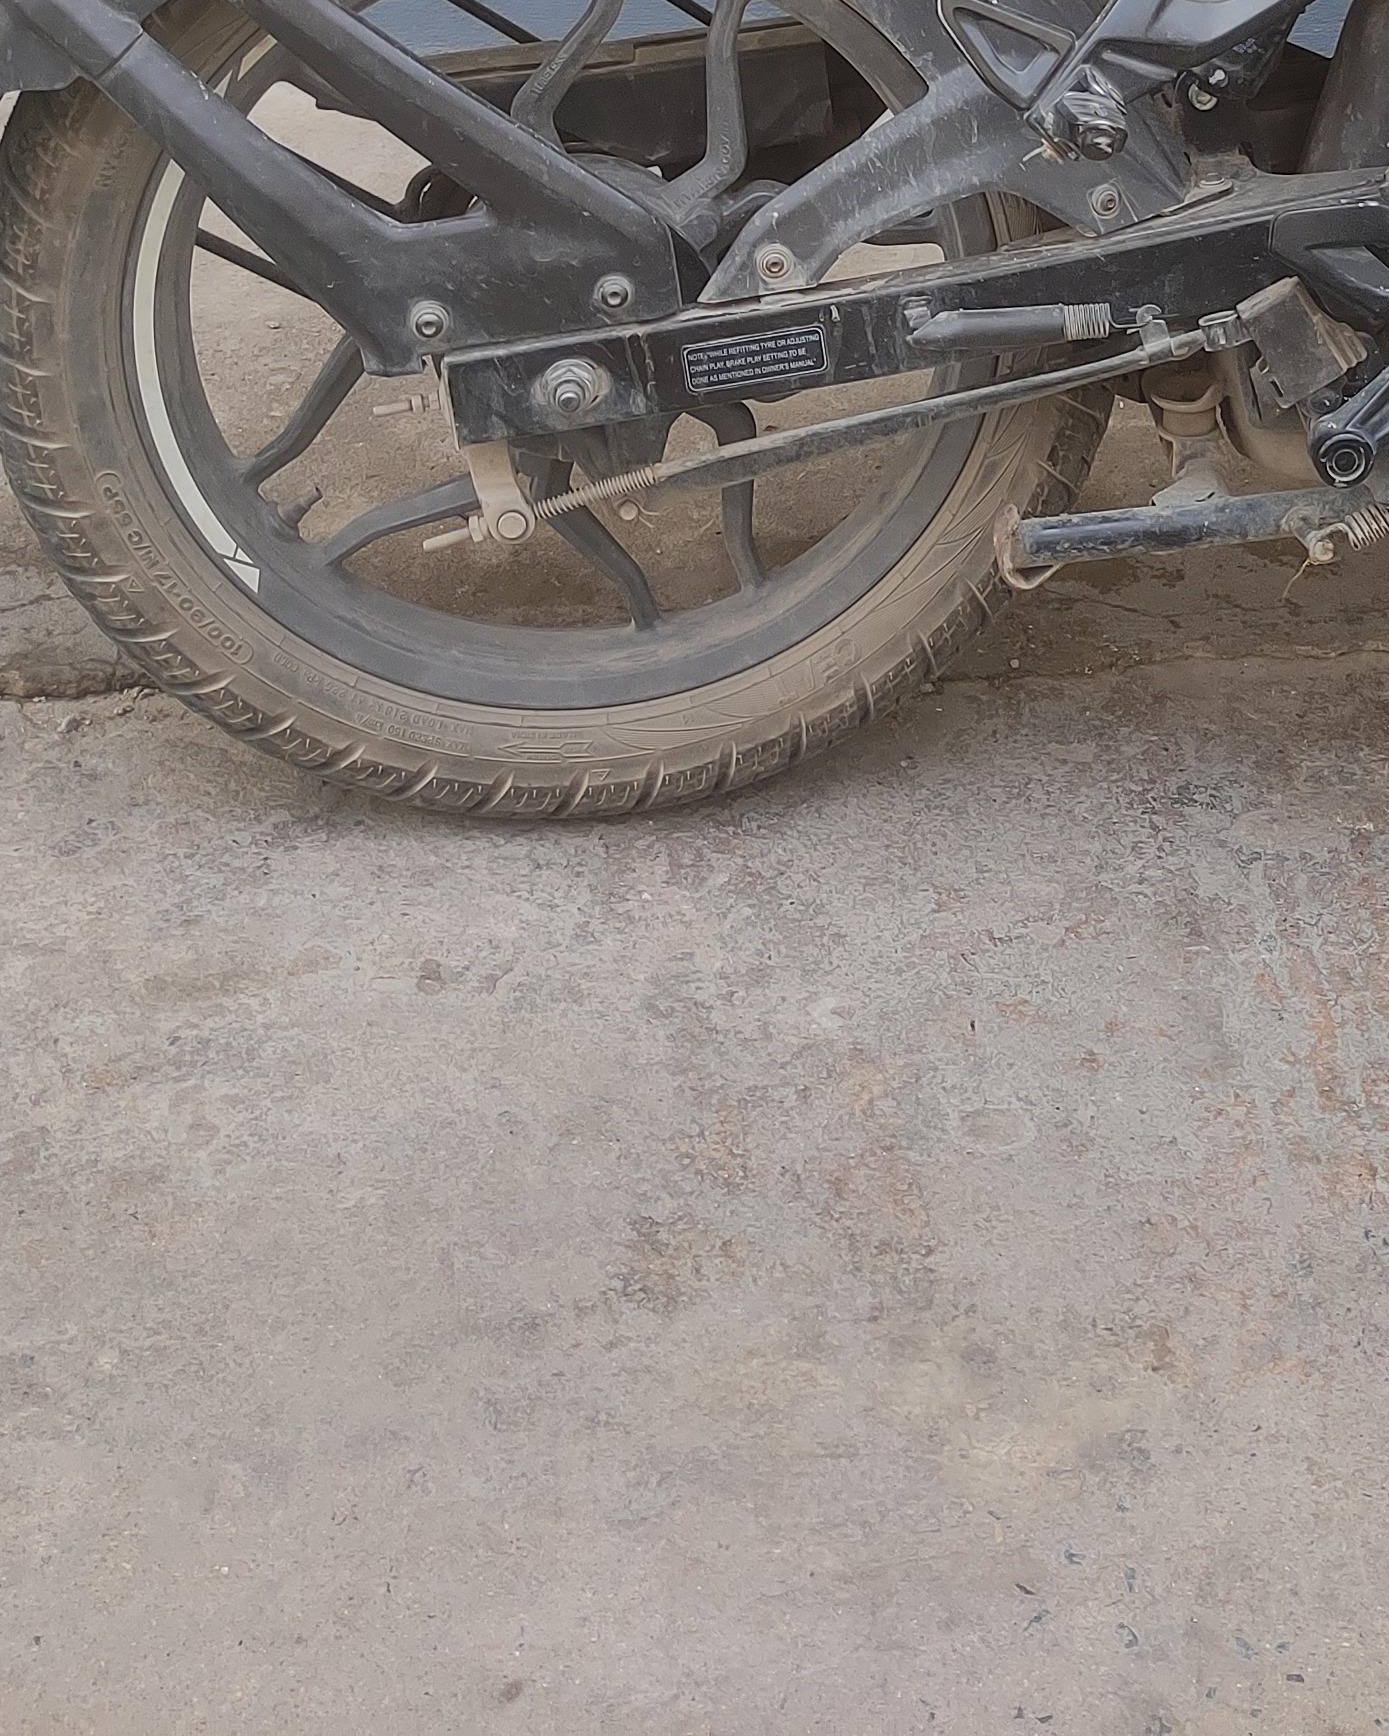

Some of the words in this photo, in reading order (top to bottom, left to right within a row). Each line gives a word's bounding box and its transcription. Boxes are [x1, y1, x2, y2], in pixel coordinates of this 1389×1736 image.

[728, 344, 760, 355] REFITTING
[760, 340, 777, 350] TYRE
[776, 339, 787, 347] OR
[787, 333, 820, 345] ADJUSTING
[690, 364, 709, 374] CHAIN
[726, 357, 747, 368] BRAKE
[746, 355, 762, 364] PLAY
[788, 349, 798, 357] TO
[797, 347, 807, 356] BE
[691, 375, 709, 385] DONE
[709, 374, 719, 382] AS
[718, 368, 754, 381] MENTIONED
[754, 367, 762, 375] IN
